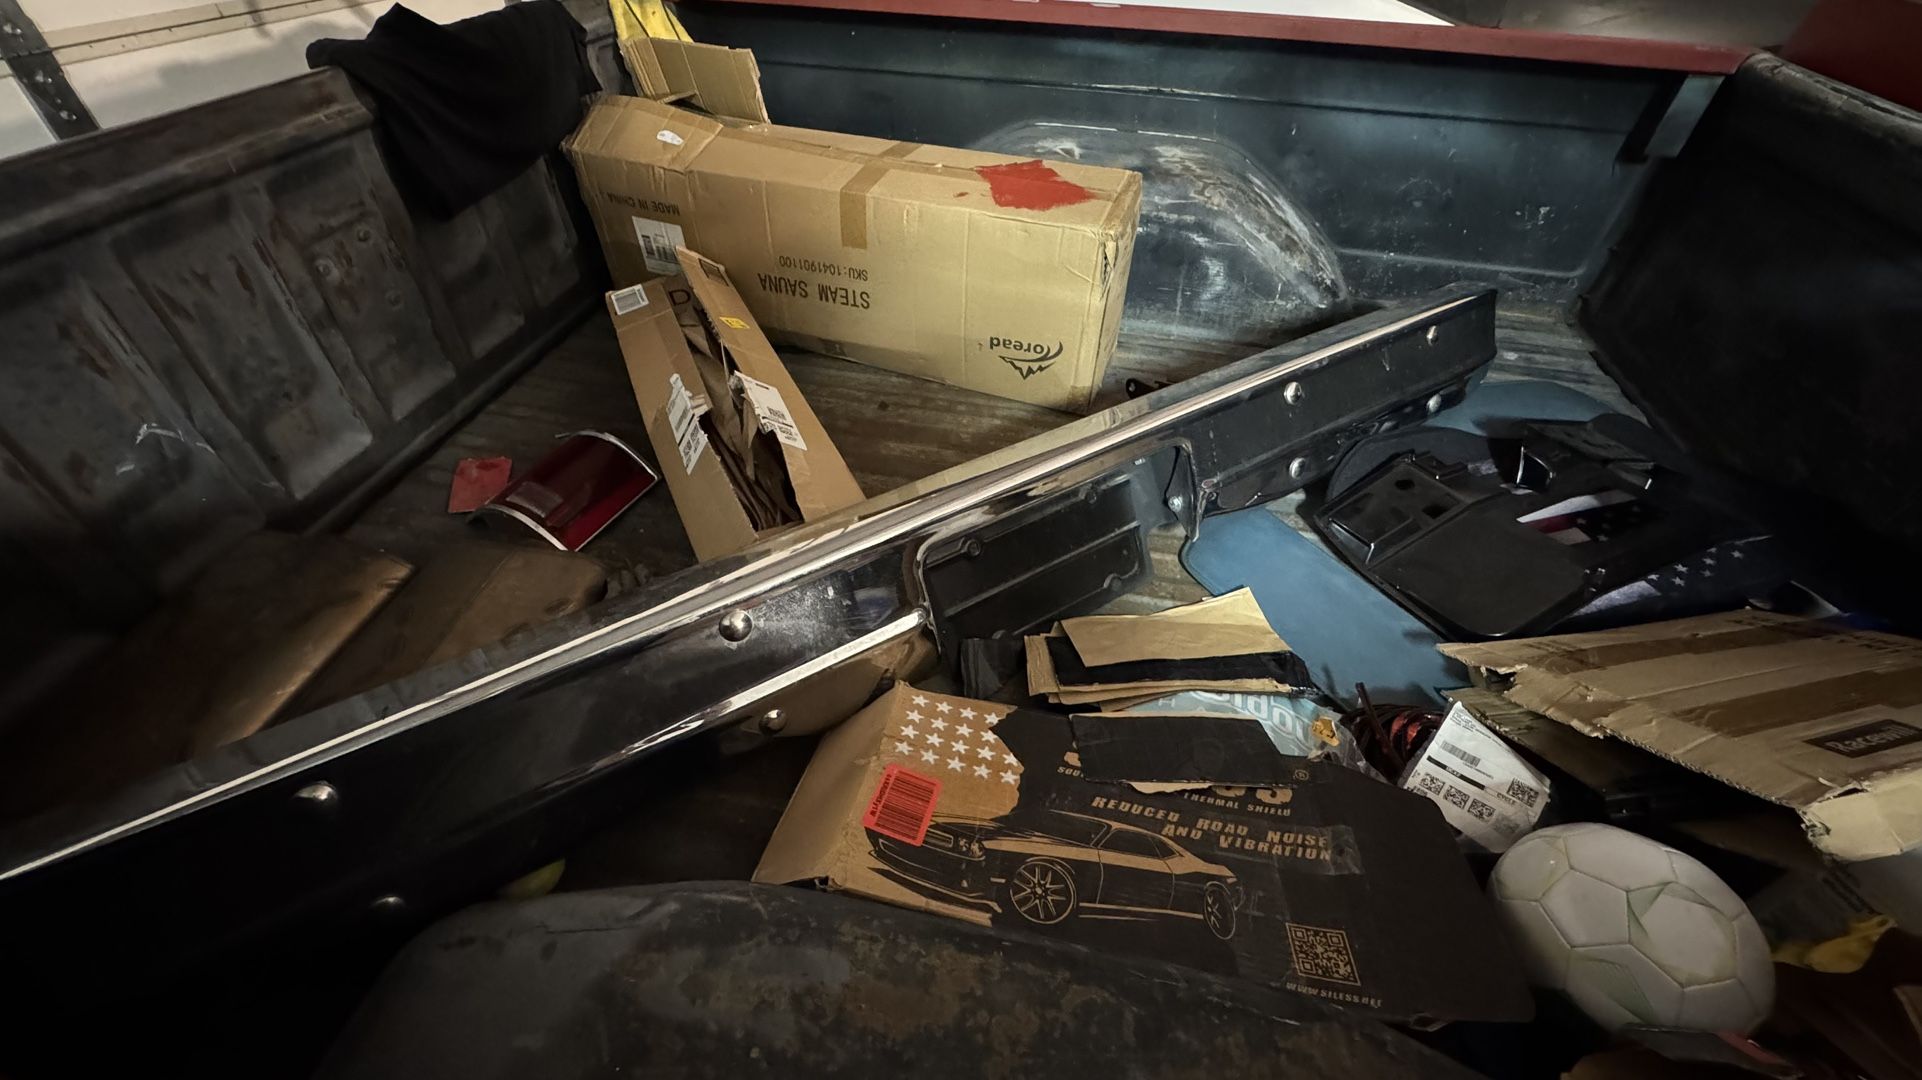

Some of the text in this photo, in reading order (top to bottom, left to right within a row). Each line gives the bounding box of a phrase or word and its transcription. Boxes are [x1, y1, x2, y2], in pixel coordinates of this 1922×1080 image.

[639, 199, 649, 211] IN
[652, 201, 680, 216] MADE
[778, 255, 869, 282] SKU:1041901100
[757, 272, 871, 310] STEAM SAUNA
[1057, 765, 1085, 779] SOU
[1247, 803, 1291, 817] SHIELD
[1090, 796, 1329, 848] REDUCED ROAD NOISE
[1161, 823, 1333, 862] AND VIBRATION
